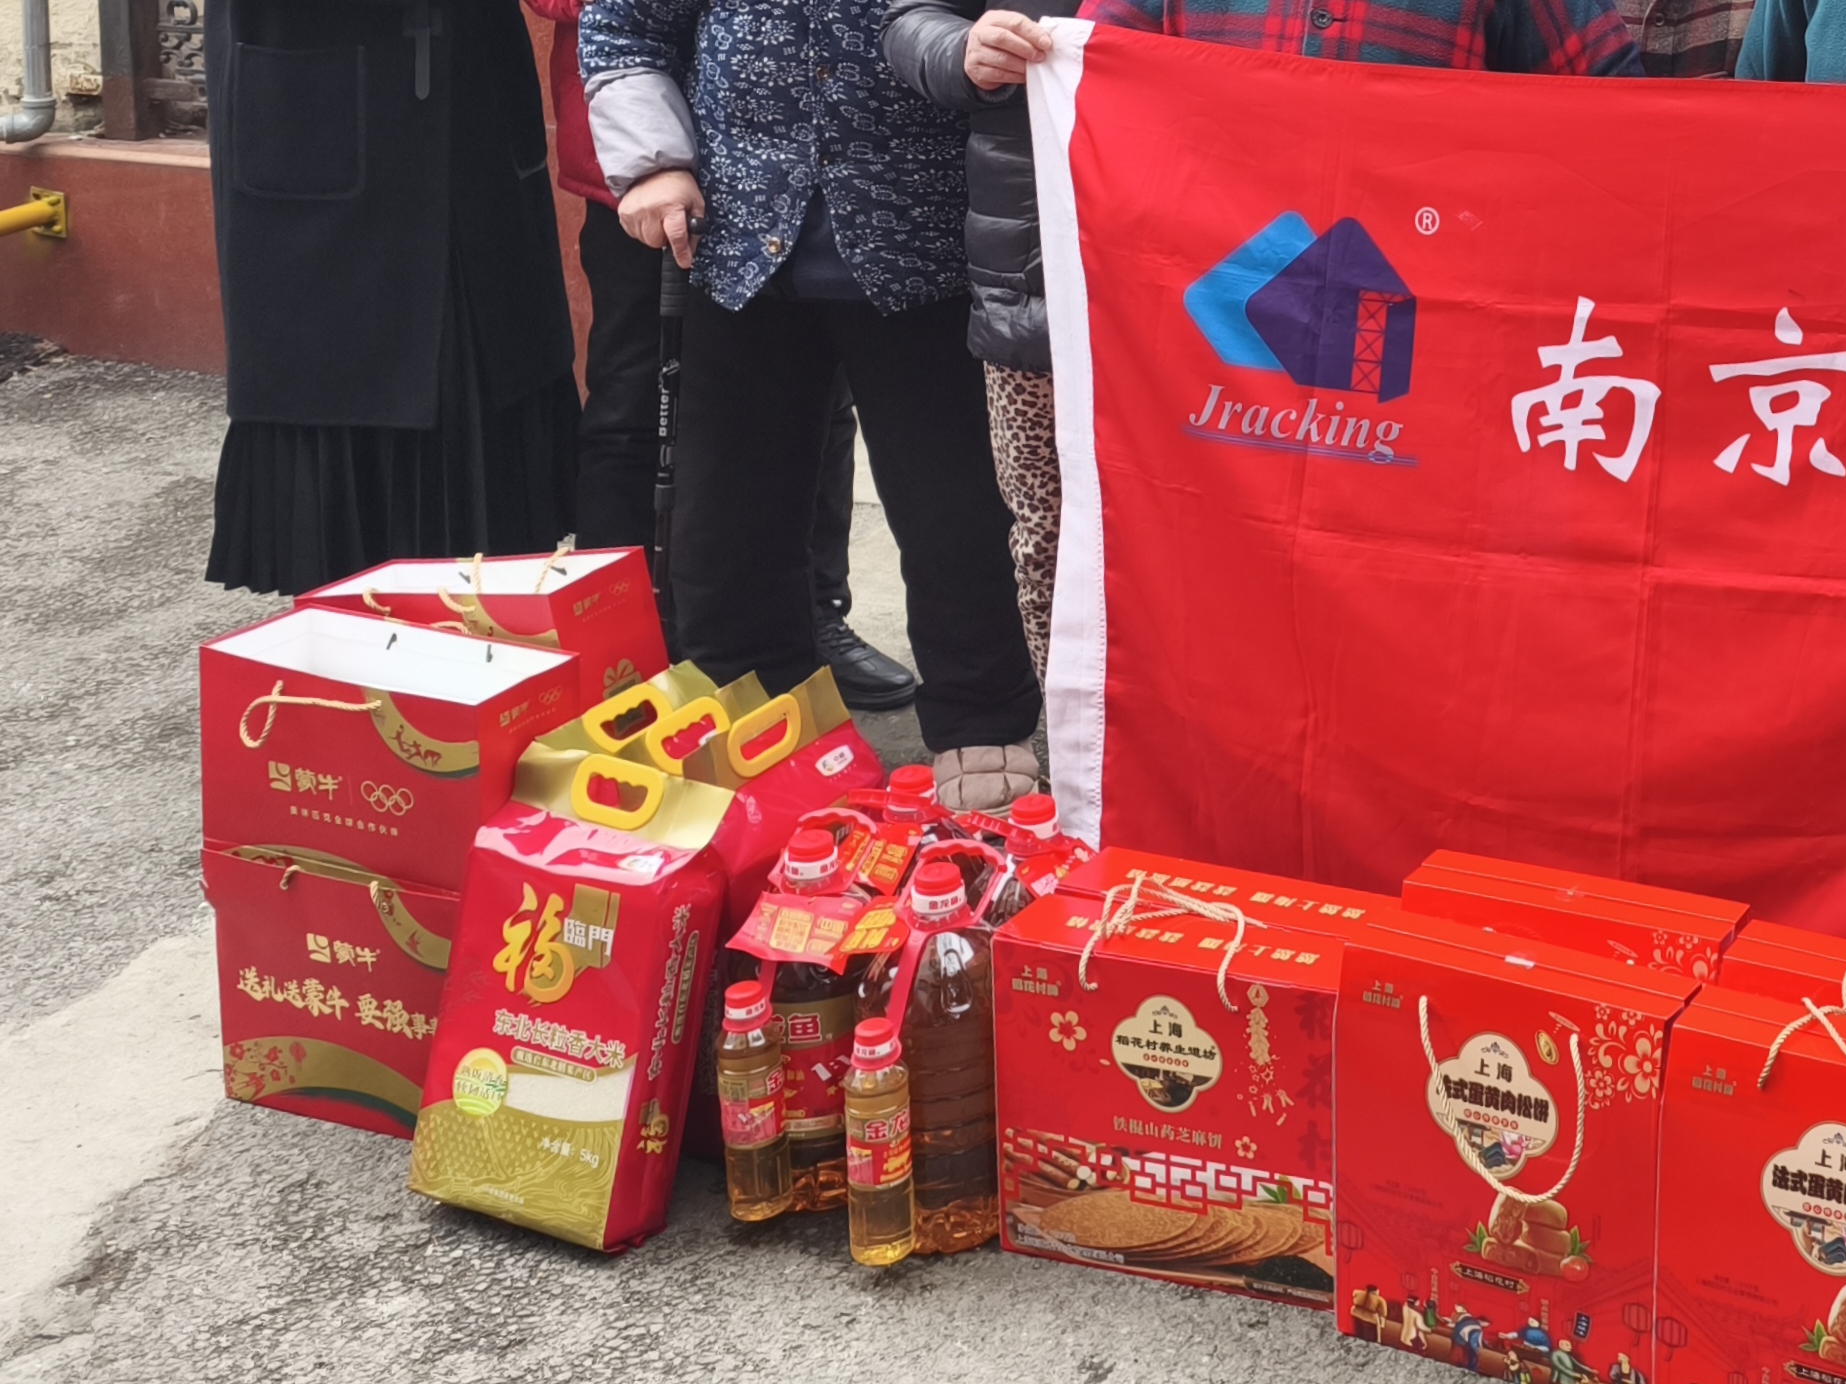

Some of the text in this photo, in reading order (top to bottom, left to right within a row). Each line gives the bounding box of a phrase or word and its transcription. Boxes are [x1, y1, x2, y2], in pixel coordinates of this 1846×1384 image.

[1187, 382, 1405, 460] Jracking
[294, 767, 338, 801] 蒙牛
[333, 940, 377, 973] 蒙牛
[493, 882, 574, 1003] 福
[236, 966, 350, 1021] 送礼送蒙牛
[493, 1008, 627, 1069] 东北长粒香大米
[1148, 1018, 1182, 1038] 上海
[1474, 1058, 1513, 1083] 上海
[1113, 1115, 1222, 1149] 铁棍山药芝麻饼
[579, 1144, 600, 1169] 5kg
